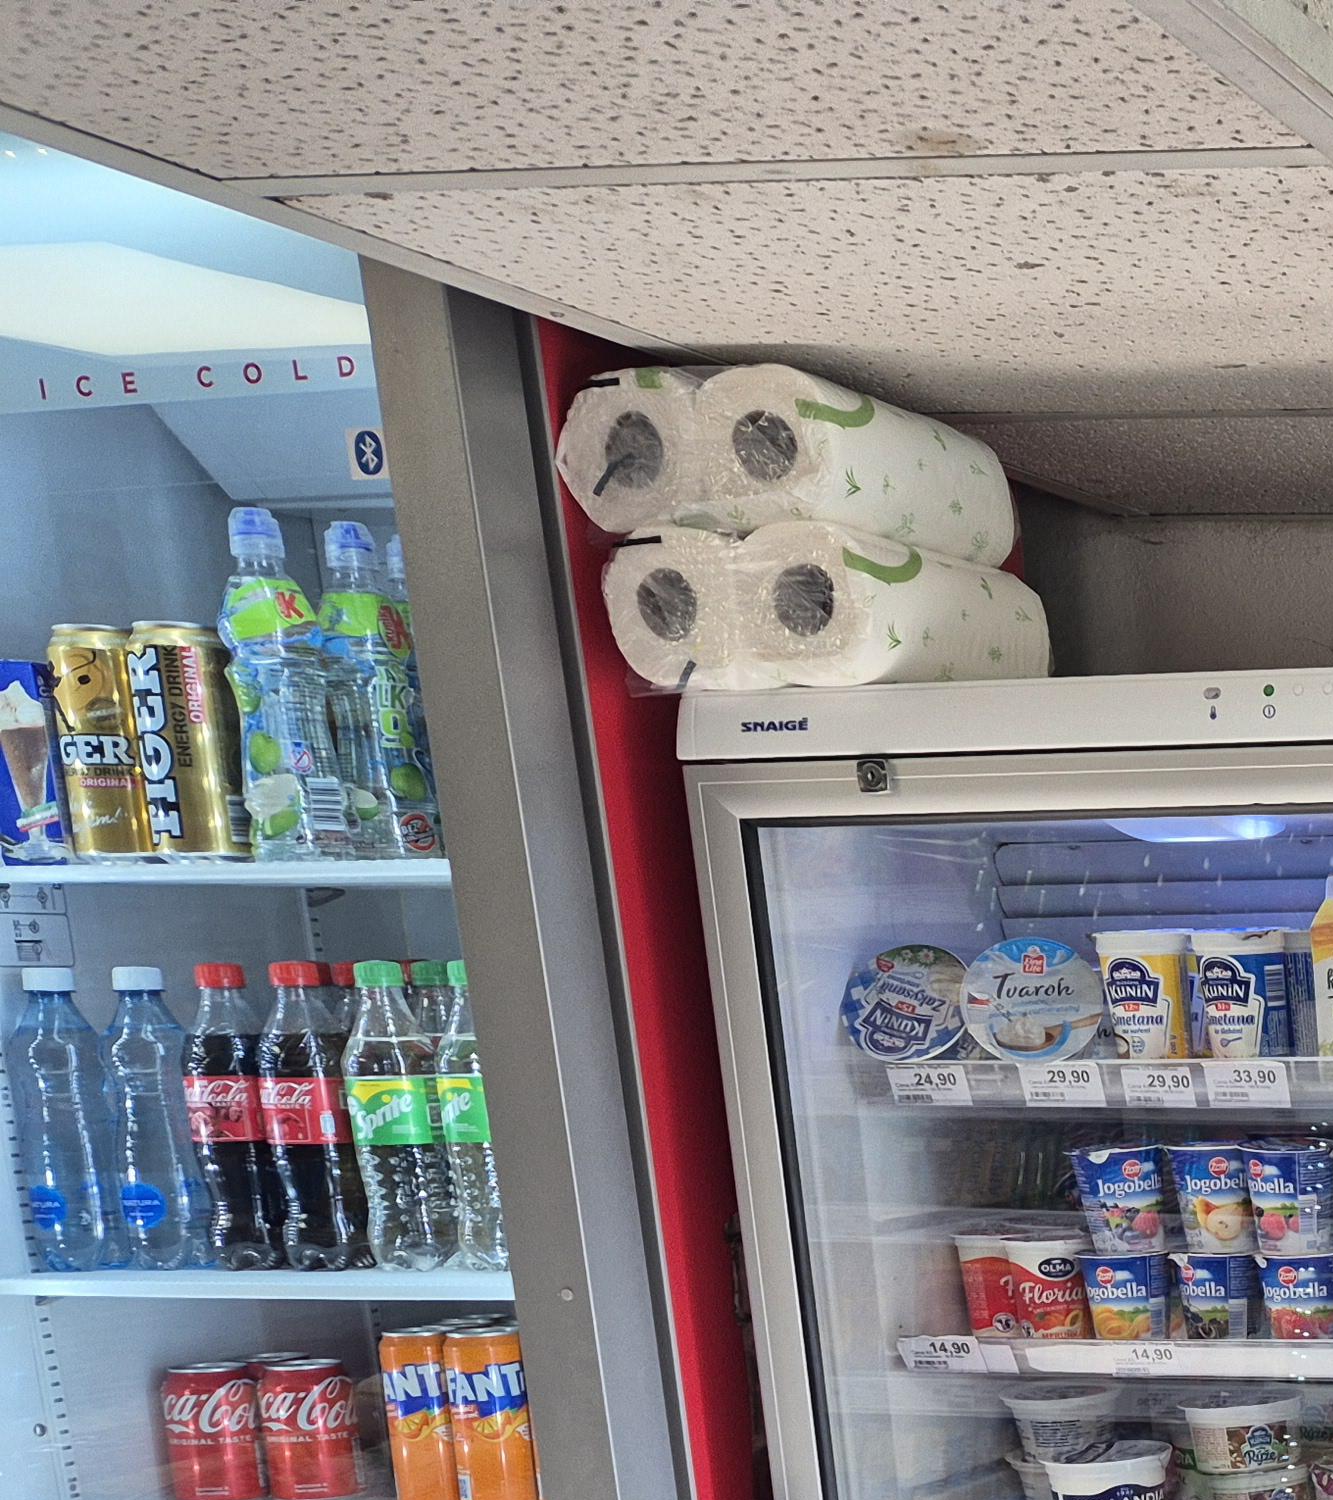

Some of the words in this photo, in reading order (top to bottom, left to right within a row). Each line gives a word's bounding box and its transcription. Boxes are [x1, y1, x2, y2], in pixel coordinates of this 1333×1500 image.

[39, 371, 138, 399] ICE
[196, 355, 356, 388] COLD
[162, 645, 181, 700] DRINK
[179, 647, 203, 723] ORIGINAL
[170, 701, 193, 767] ENERGY
[59, 734, 136, 766] GER
[127, 647, 180, 847] TIGER
[80, 777, 136, 788] ORIGINA
[993, 972, 1074, 998] Tvaroh
[1112, 1013, 1163, 1026] Smetana
[1206, 1013, 1255, 1026] Smetana
[914, 1073, 957, 1088] 24,90
[1047, 1070, 1090, 1085] 29,90
[1147, 1075, 1190, 1090] 29,90
[1233, 1070, 1276, 1085] 33,90
[357, 1093, 412, 1140] Sprite
[1097, 1172, 1161, 1198] Jogobella
[1186, 1174, 1248, 1196] Jogobell
[1041, 1262, 1073, 1273] OLMA
[1020, 1282, 1085, 1306] Floria
[1086, 1282, 1147, 1302] ogobella
[929, 1342, 970, 1357] 14,90
[1132, 1348, 1172, 1362] 14,90
[383, 1364, 441, 1398] ANT
[447, 1363, 524, 1401] FANT
